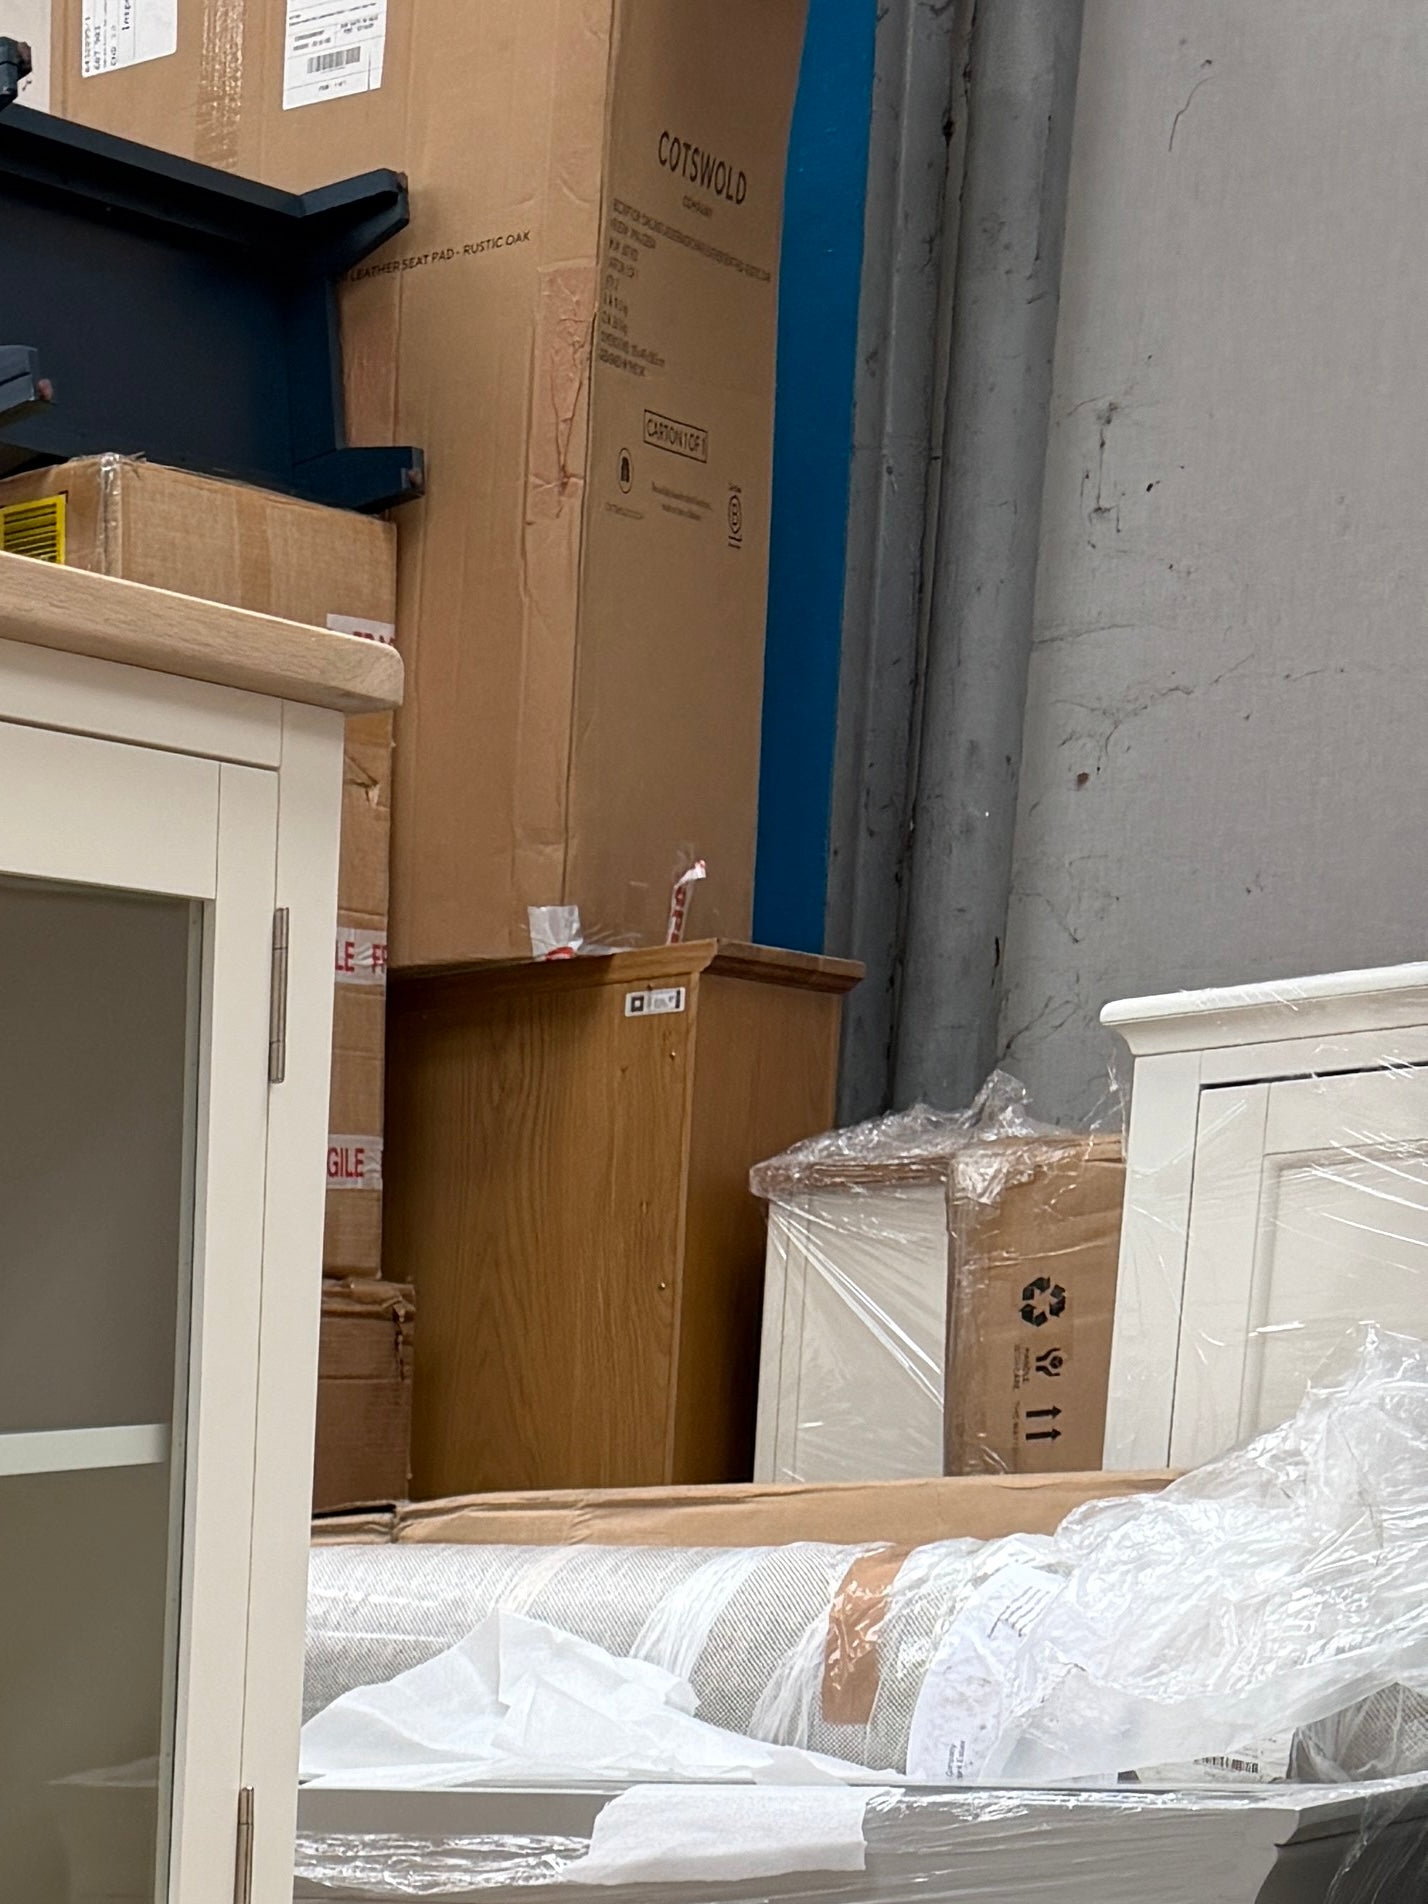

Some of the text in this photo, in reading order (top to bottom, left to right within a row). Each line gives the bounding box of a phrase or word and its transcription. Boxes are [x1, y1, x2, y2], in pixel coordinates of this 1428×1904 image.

[657, 130, 747, 205] COTSWOLD
[350, 261, 400, 282] LEATHER
[401, 254, 429, 271] SEAT
[431, 248, 455, 264] PAD
[462, 236, 503, 257] RUSTIC
[505, 230, 531, 246] OAK
[647, 419, 683, 448] CARTON
